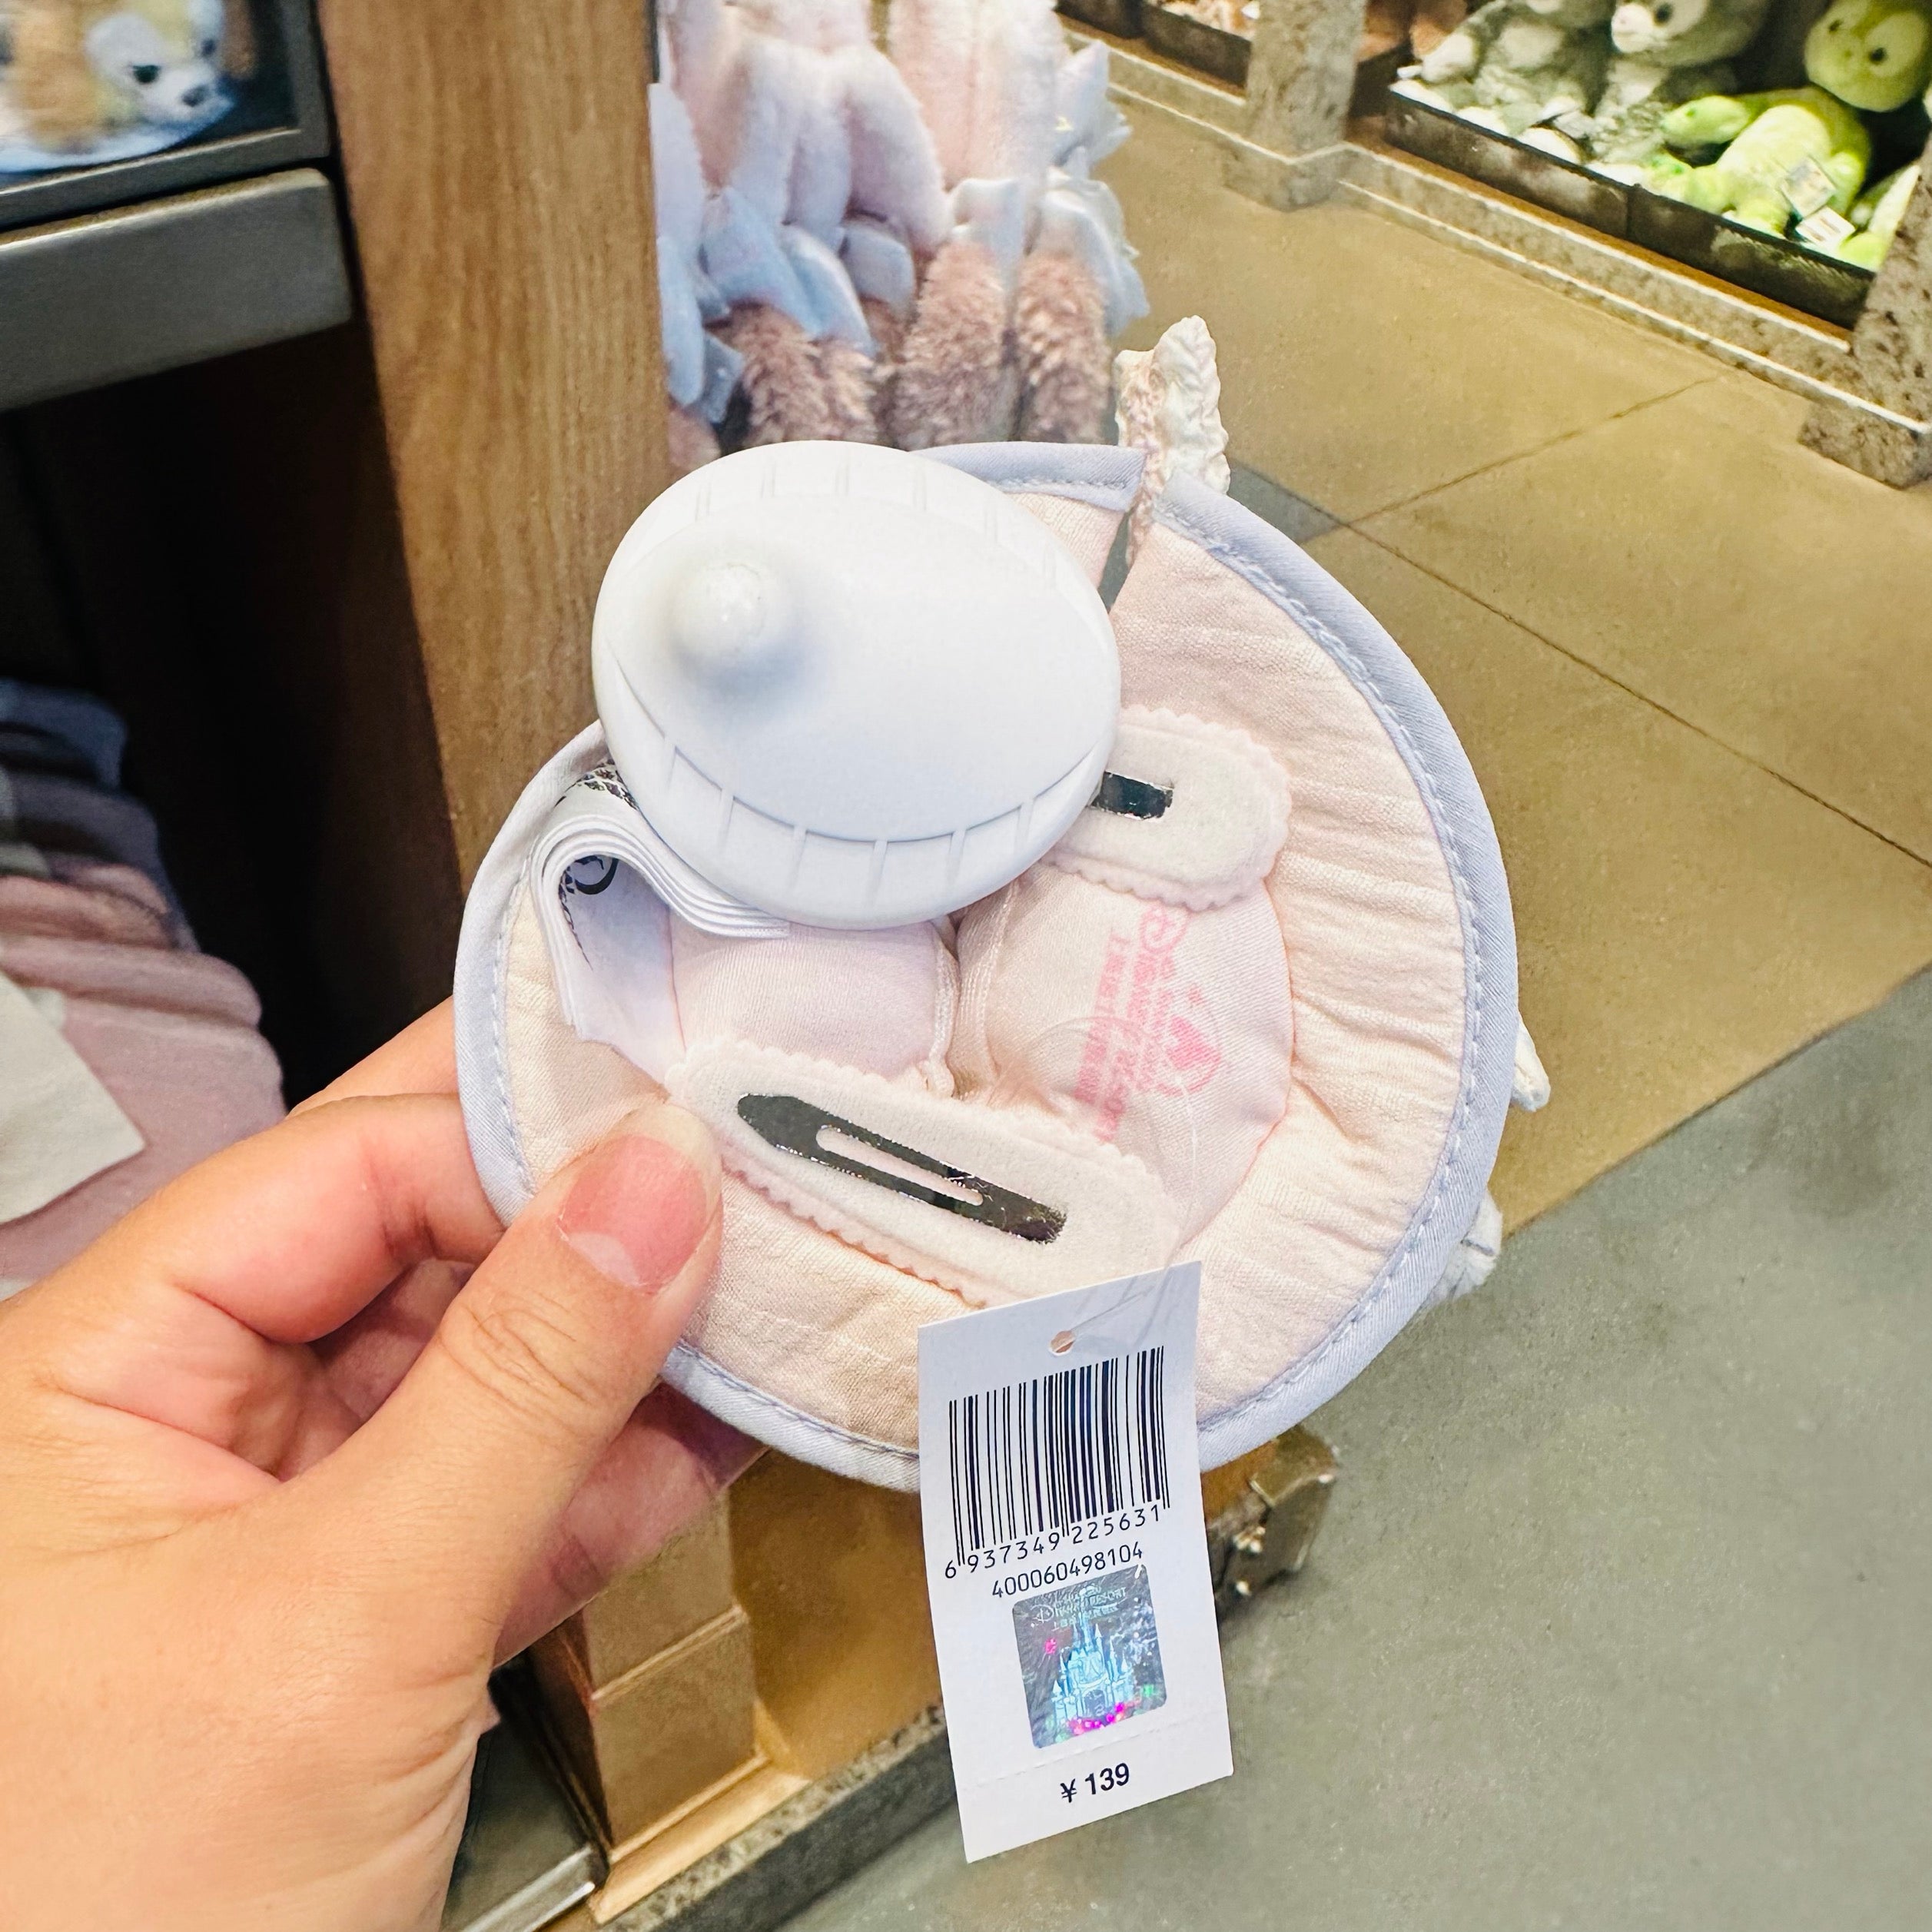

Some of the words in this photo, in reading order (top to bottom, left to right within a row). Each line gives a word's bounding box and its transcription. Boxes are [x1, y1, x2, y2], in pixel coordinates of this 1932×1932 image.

[944, 1559, 957, 1579] 6
[967, 1532, 1060, 1573] 937349
[1071, 1504, 1159, 1545] 225631
[992, 1541, 1143, 1598] 400060498104
[1060, 1778, 1077, 1803] ¥
[1084, 1762, 1130, 1794] 139
